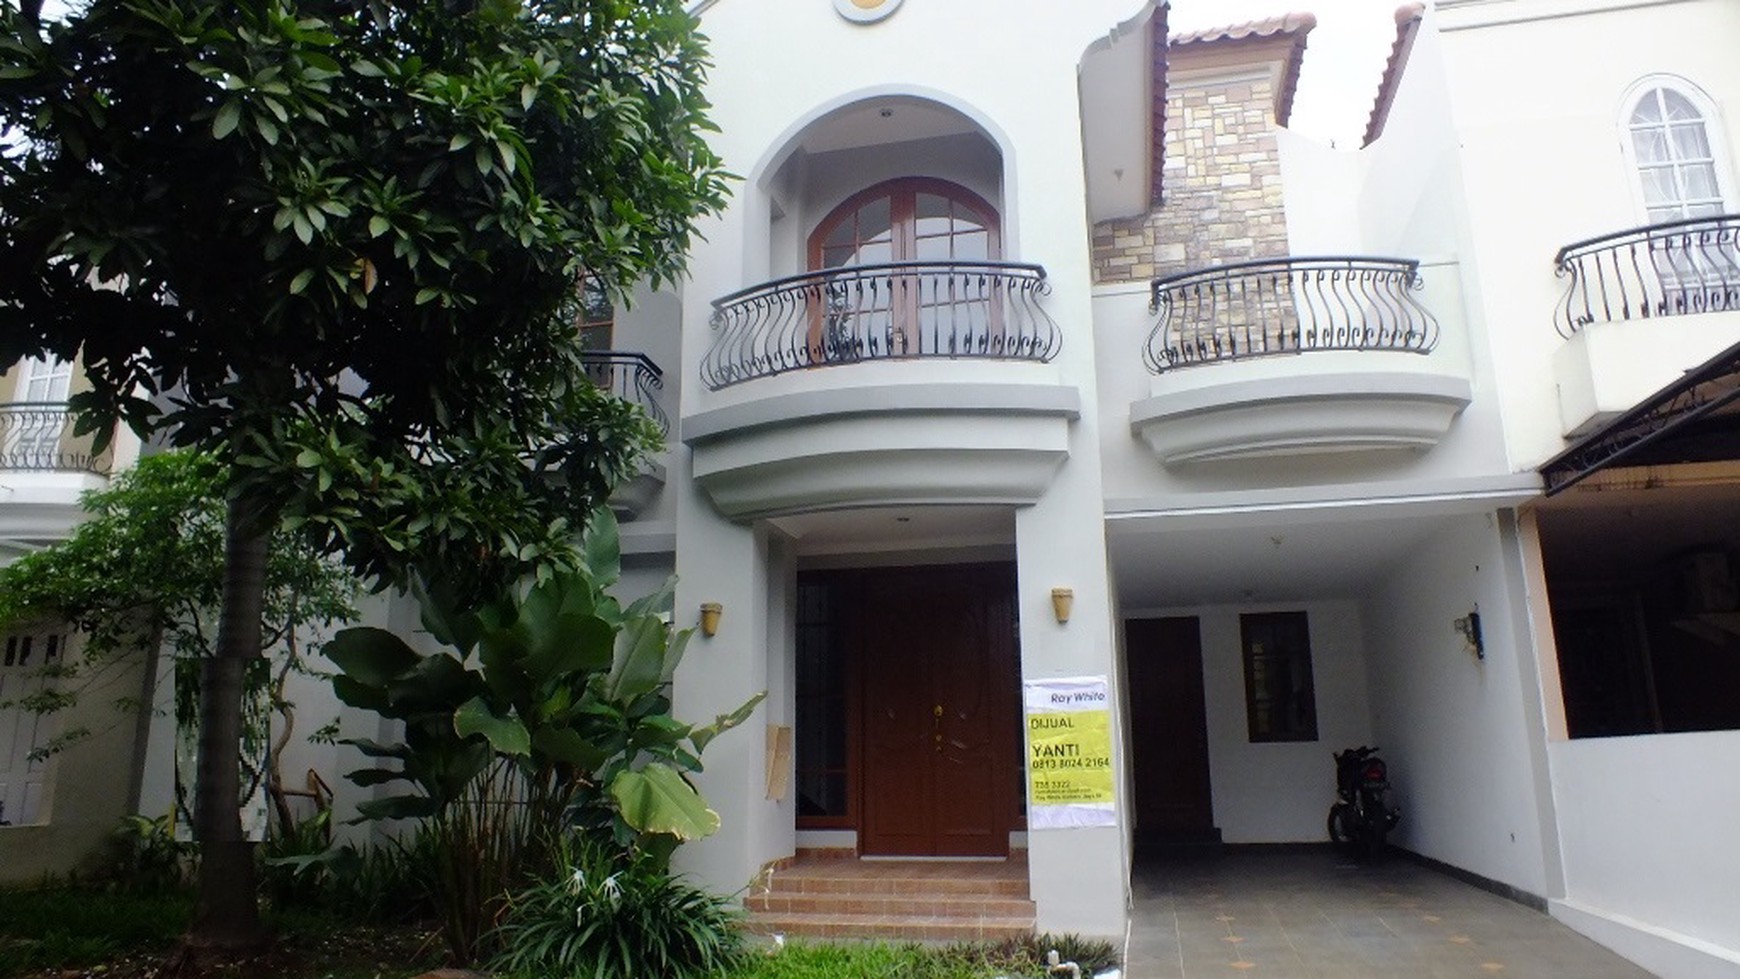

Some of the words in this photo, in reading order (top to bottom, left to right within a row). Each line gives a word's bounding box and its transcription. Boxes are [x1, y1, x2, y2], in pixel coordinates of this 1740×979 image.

[1051, 692, 1073, 704] Ray
[1074, 691, 1106, 702] White
[1030, 717, 1075, 730] DIJUAL
[1032, 743, 1080, 757] YANTI
[1032, 760, 1056, 769] 0813
[1085, 757, 1110, 768] 2164
